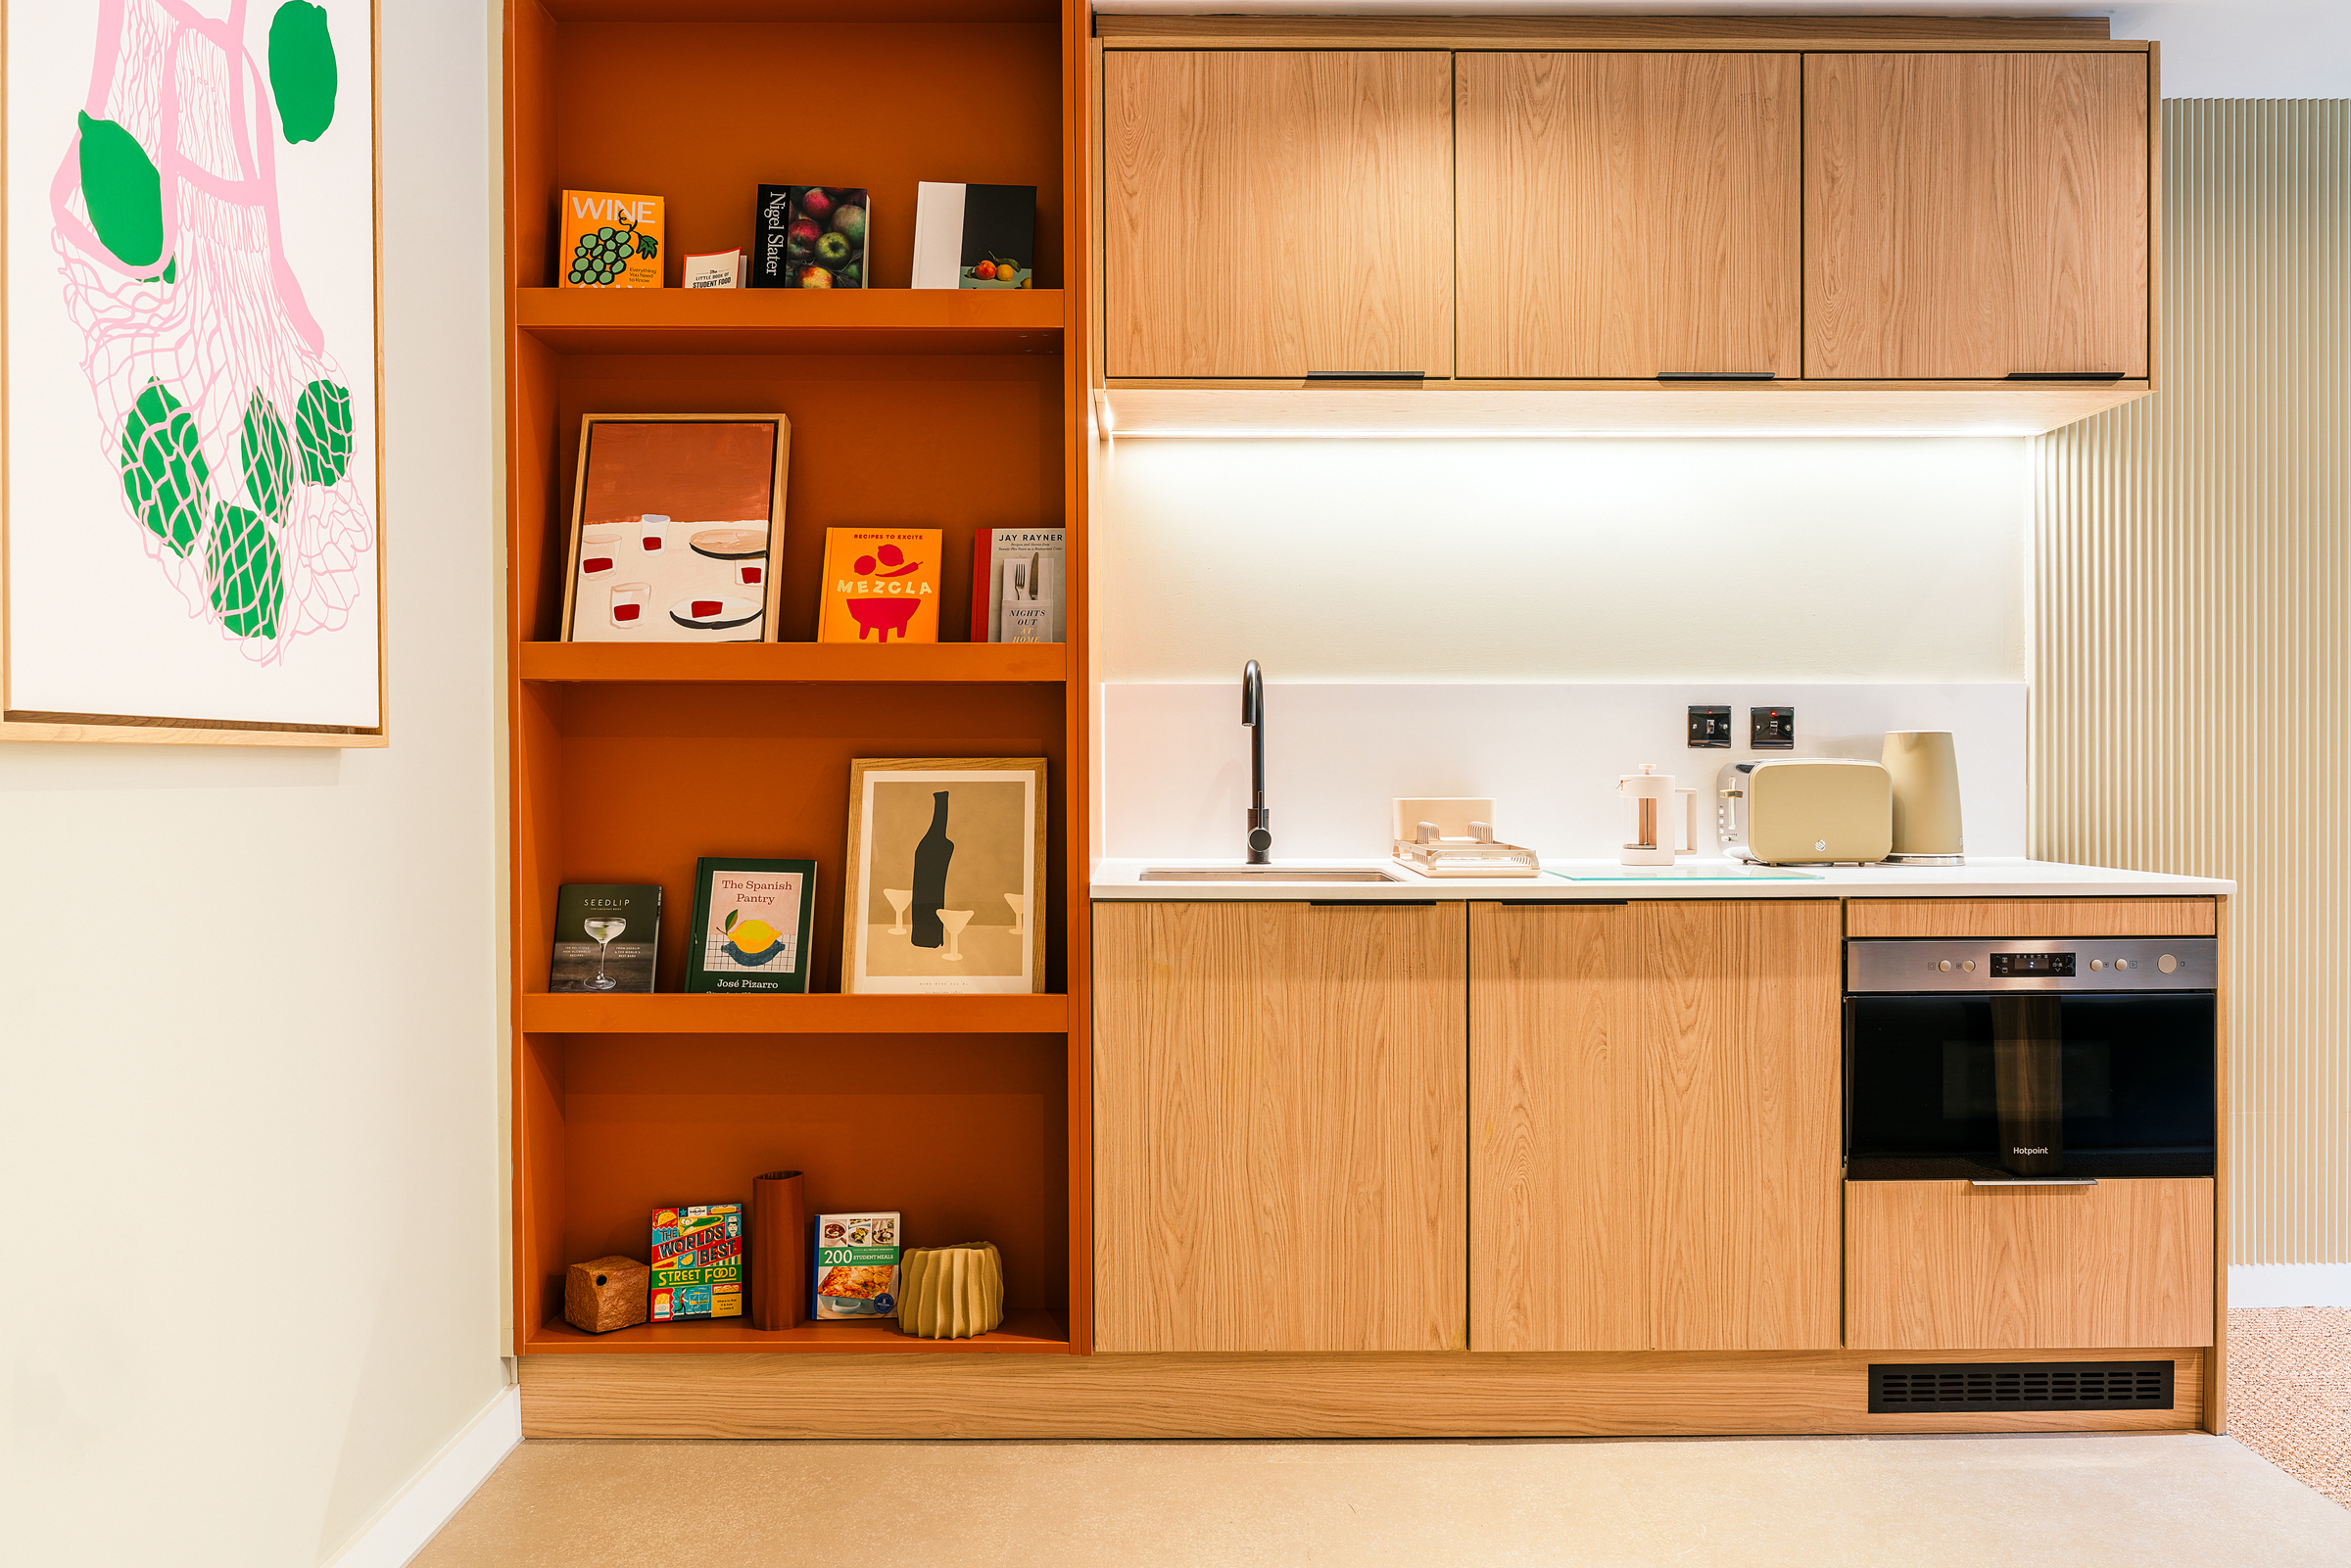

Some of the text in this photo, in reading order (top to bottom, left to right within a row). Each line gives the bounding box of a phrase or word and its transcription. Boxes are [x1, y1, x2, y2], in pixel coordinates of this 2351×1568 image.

[572, 197, 655, 223] WINE
[764, 192, 786, 230] Nigel
[766, 234, 785, 276] Slater
[718, 277, 732, 286] FOOD
[837, 579, 933, 594] MEZCLA
[722, 879, 792, 892] The Spanish
[584, 898, 630, 907] SEEDLIP
[737, 893, 775, 905] Pantry
[717, 978, 779, 989] José Pizarro
[2013, 1146, 2049, 1157] Hotpoint
[658, 1230, 677, 1241] THE
[658, 1225, 724, 1259] WORLD'S
[698, 1240, 736, 1265] BEST
[824, 1249, 853, 1264] 200
[658, 1267, 737, 1286] STREET FOOD
